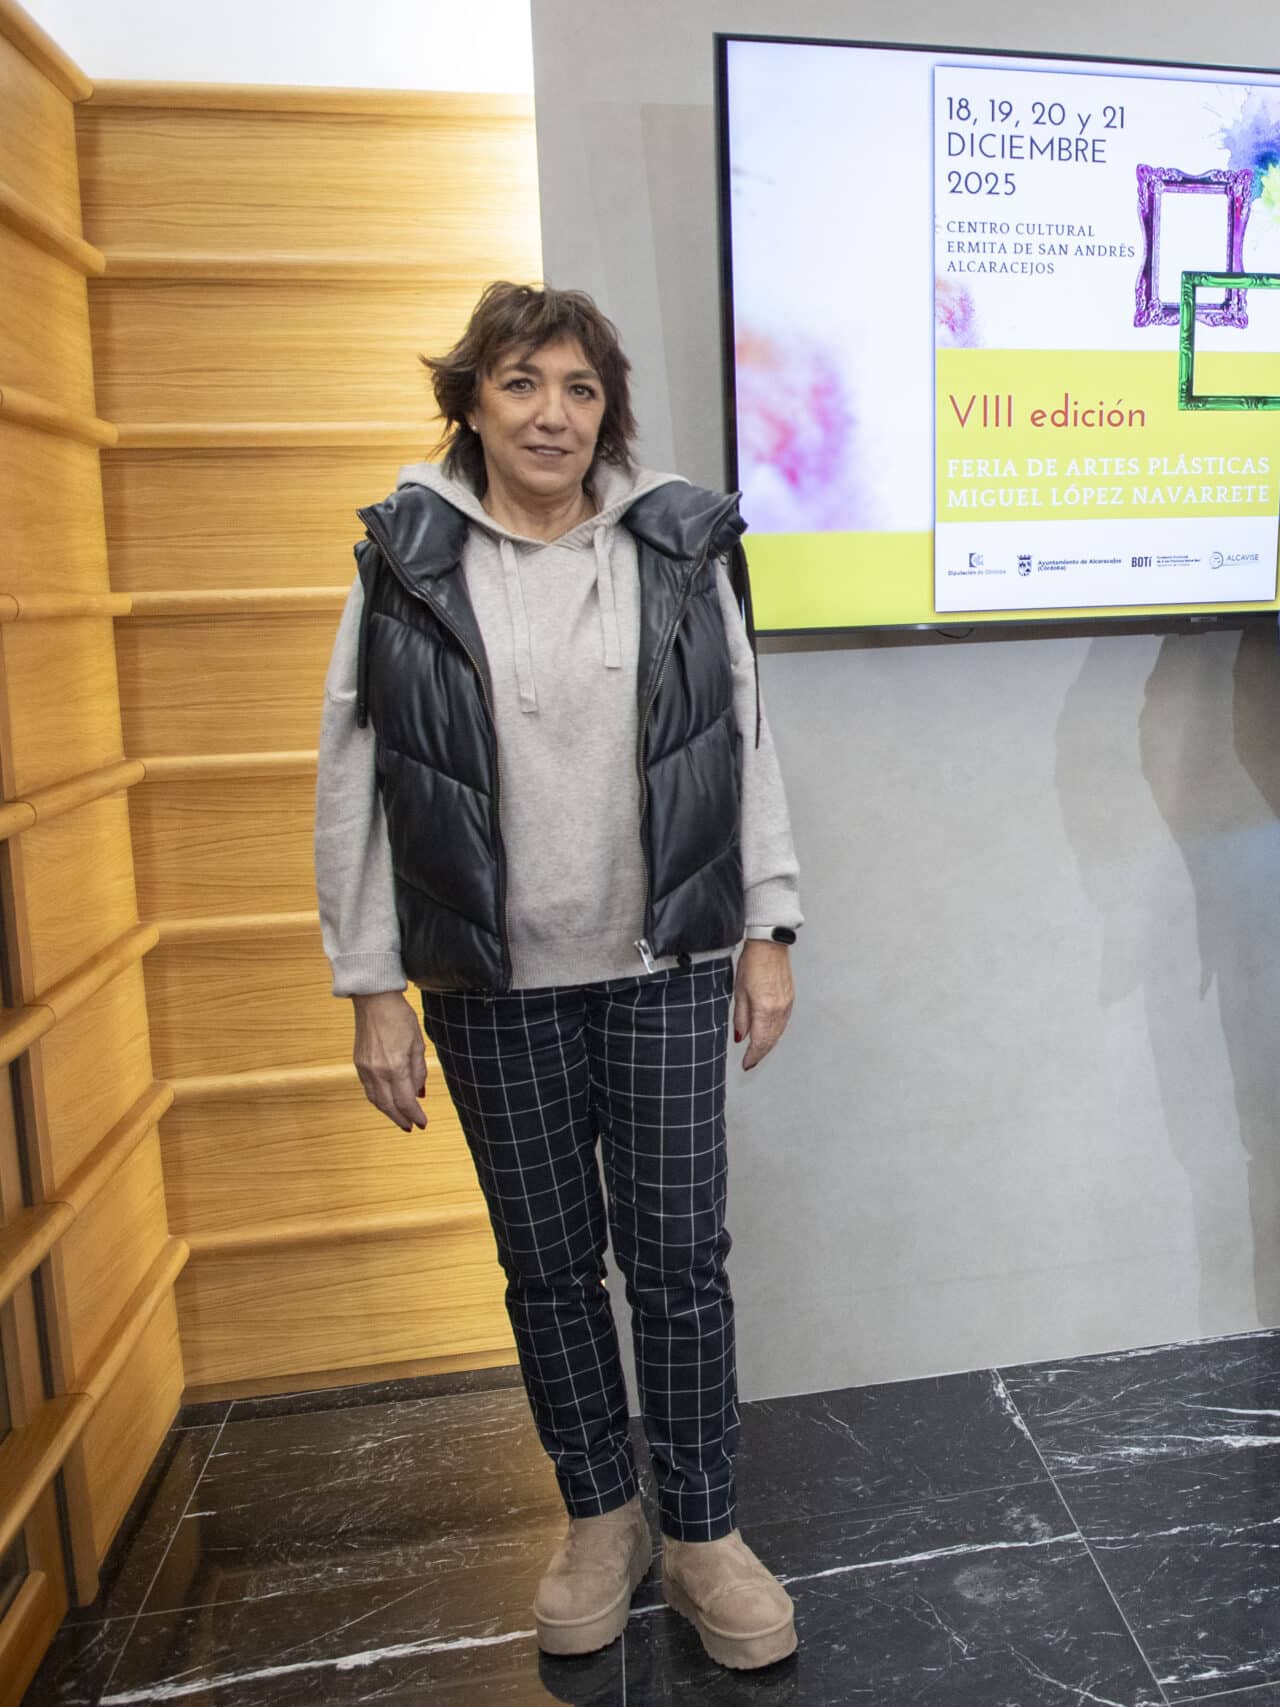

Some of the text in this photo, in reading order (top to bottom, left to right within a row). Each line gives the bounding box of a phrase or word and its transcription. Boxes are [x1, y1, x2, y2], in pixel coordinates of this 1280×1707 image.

[947, 96, 1125, 135] 18, 19, 20 y 21
[947, 131, 1107, 163] DICIEMBRE
[947, 170, 1017, 196] 2025
[946, 220, 1096, 237] CENTRO CULTURAL
[947, 241, 1136, 258] ERMITA DE SAN ANDRÉS
[946, 260, 1055, 276] ALCARACEJOS
[949, 392, 1146, 429] VIII edición
[947, 453, 1270, 479] FERIA DE ARTES PLÁSTICAS
[947, 483, 1270, 508] MIGUEL LÓPEZ NAVARRETE
